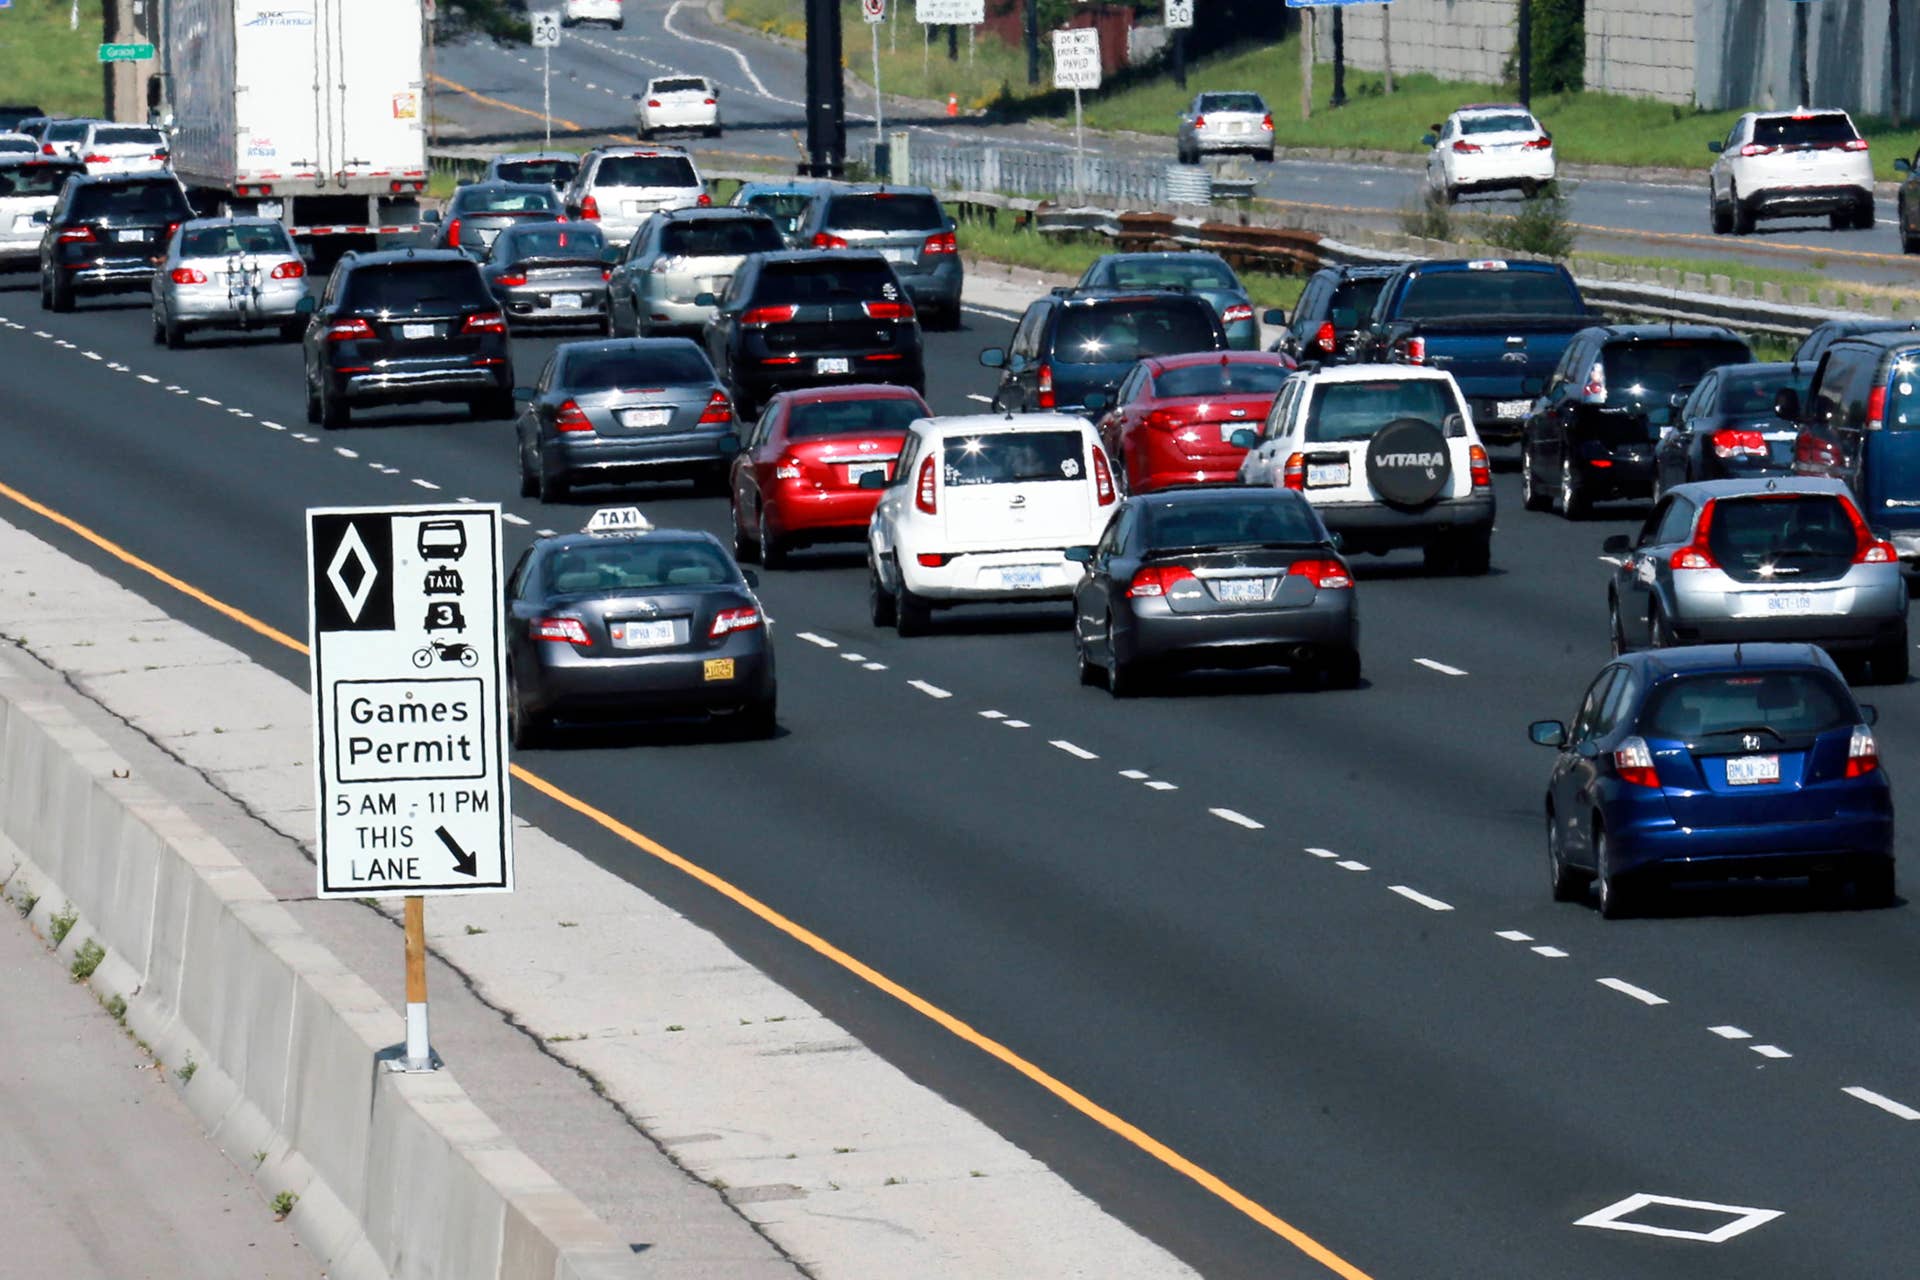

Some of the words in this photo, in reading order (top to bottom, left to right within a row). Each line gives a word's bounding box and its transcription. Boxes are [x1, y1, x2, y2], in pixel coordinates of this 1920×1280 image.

[1168, 8, 1189, 23] 50
[536, 26, 557, 42] 50
[1375, 451, 1444, 468] VITARA
[599, 511, 637, 526] TAXI
[428, 575, 458, 589] TAXI
[436, 605, 453, 625] 3
[351, 697, 468, 724] Games
[350, 734, 471, 765] Permit
[337, 794, 351, 816] 5
[360, 793, 397, 815] AM
[428, 791, 445, 813] 11
[455, 790, 489, 813] PM
[355, 825, 414, 849] THIS
[351, 857, 422, 881] LANE
